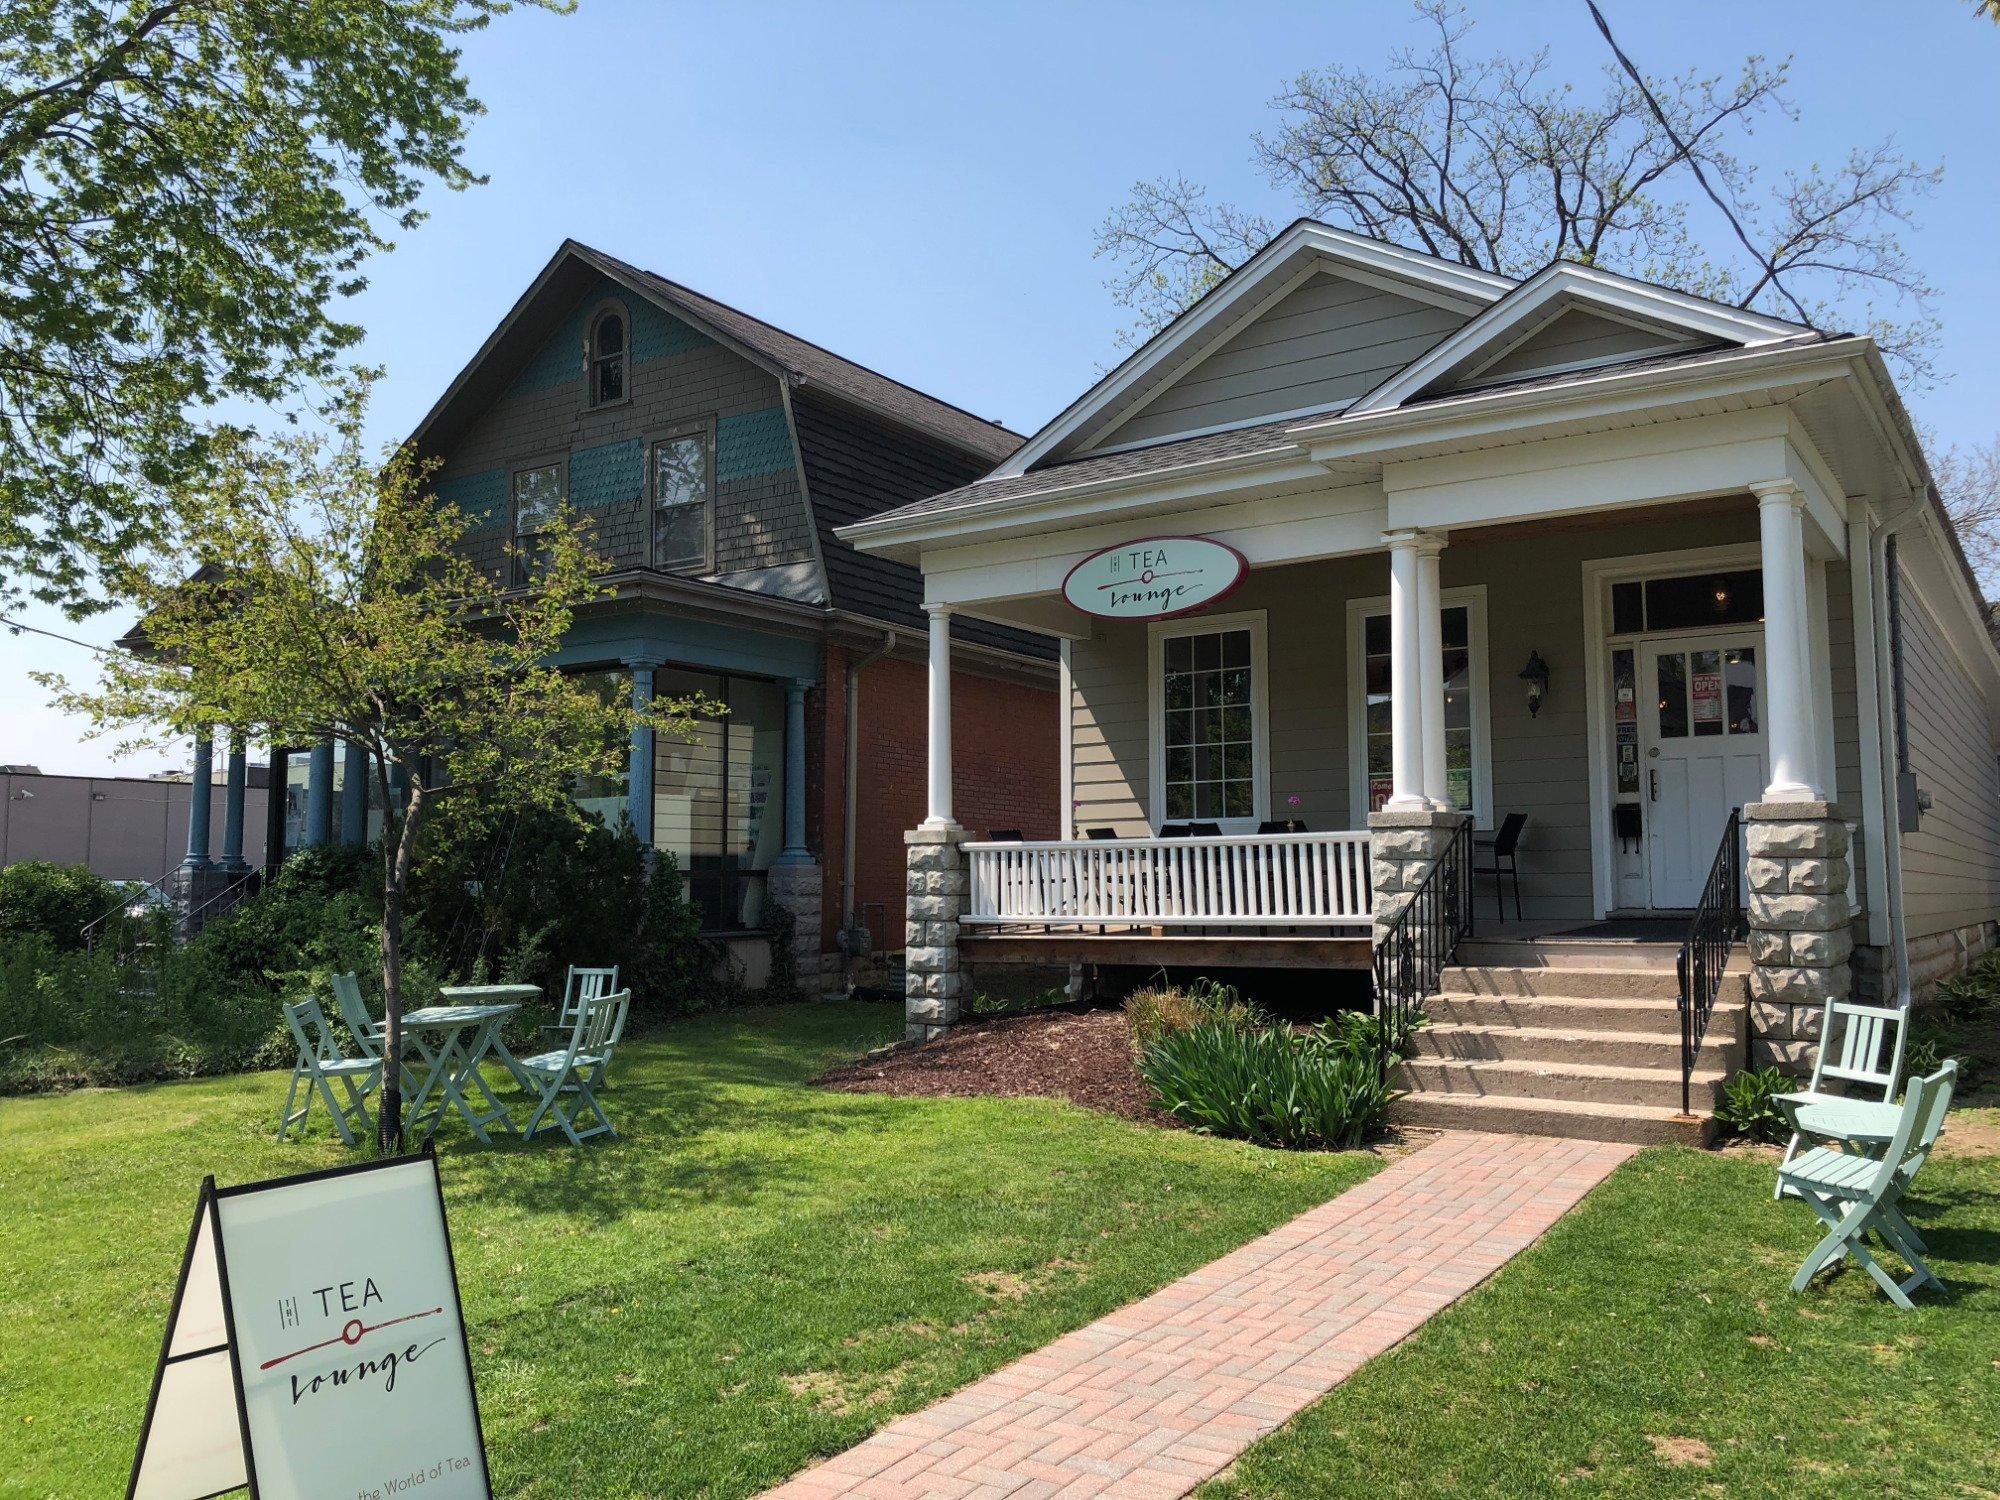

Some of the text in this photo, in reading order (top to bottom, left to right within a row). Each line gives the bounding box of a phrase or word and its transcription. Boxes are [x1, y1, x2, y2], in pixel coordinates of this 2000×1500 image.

[1128, 549, 1168, 570] TEA
[1110, 583, 1203, 611] Lounge
[1694, 680, 1721, 692] OPEN
[312, 1277, 383, 1317] TEA
[291, 1336, 446, 1405] Lounge
[384, 1470, 426, 1496] World
[429, 1462, 444, 1480] of
[446, 1456, 471, 1473] Tea
